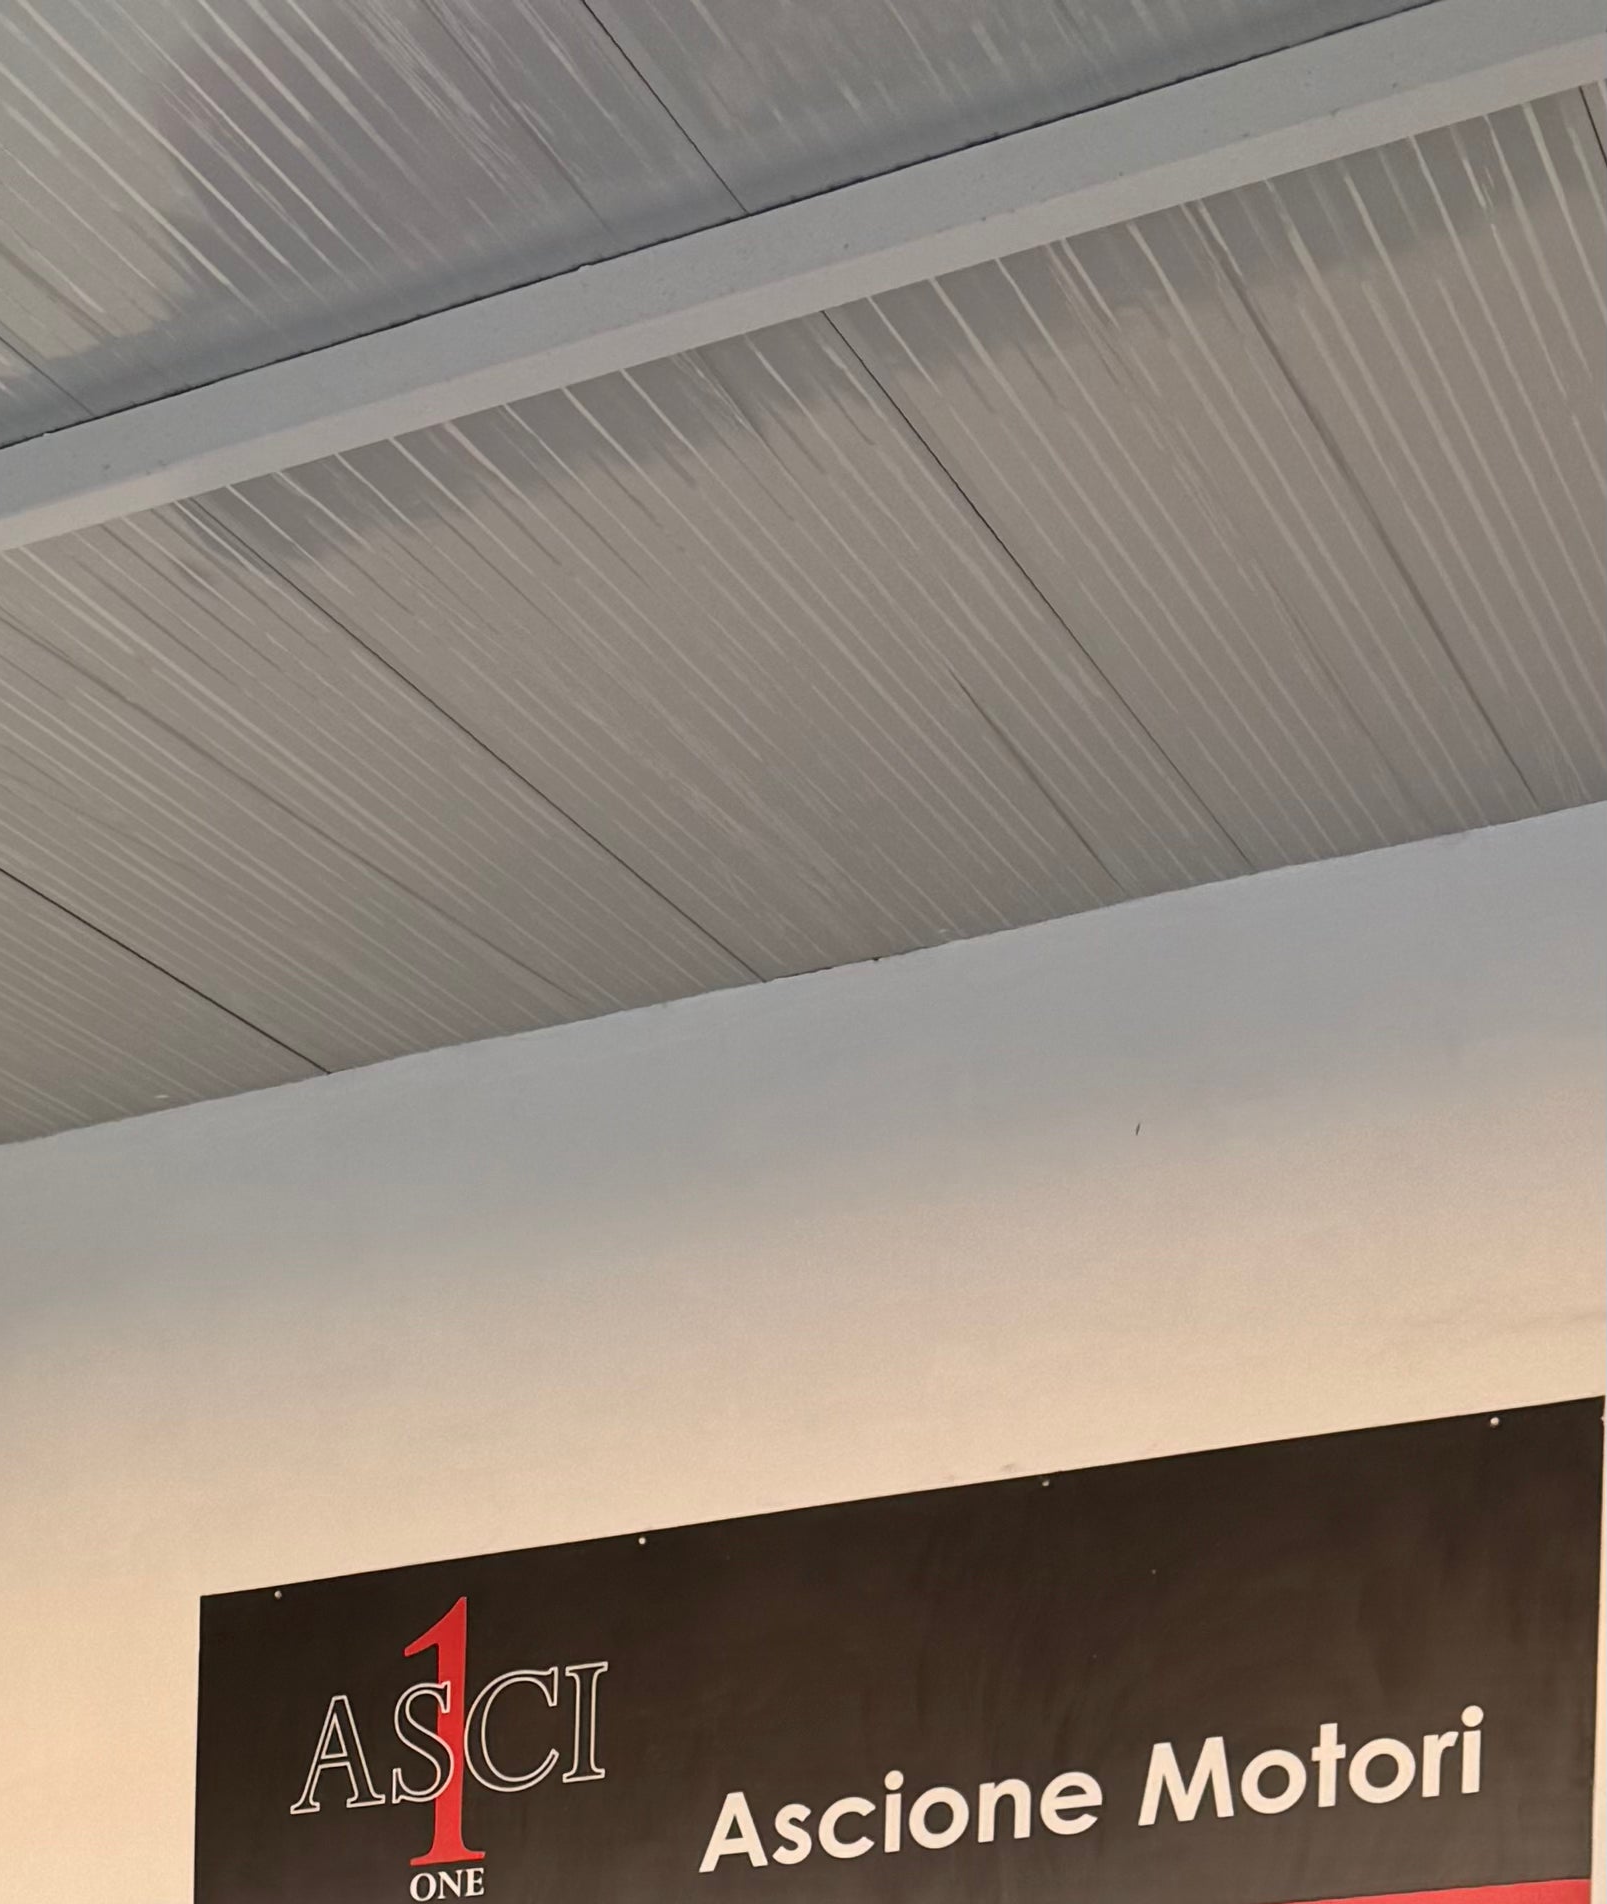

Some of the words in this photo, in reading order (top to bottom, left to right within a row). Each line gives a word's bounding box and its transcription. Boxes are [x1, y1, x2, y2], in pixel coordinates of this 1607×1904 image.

[290, 1661, 608, 1815] ASCI
[698, 1769, 1104, 1874] Ascione
[1137, 1704, 1486, 1827] Motori
[410, 1867, 485, 1902] ONE
